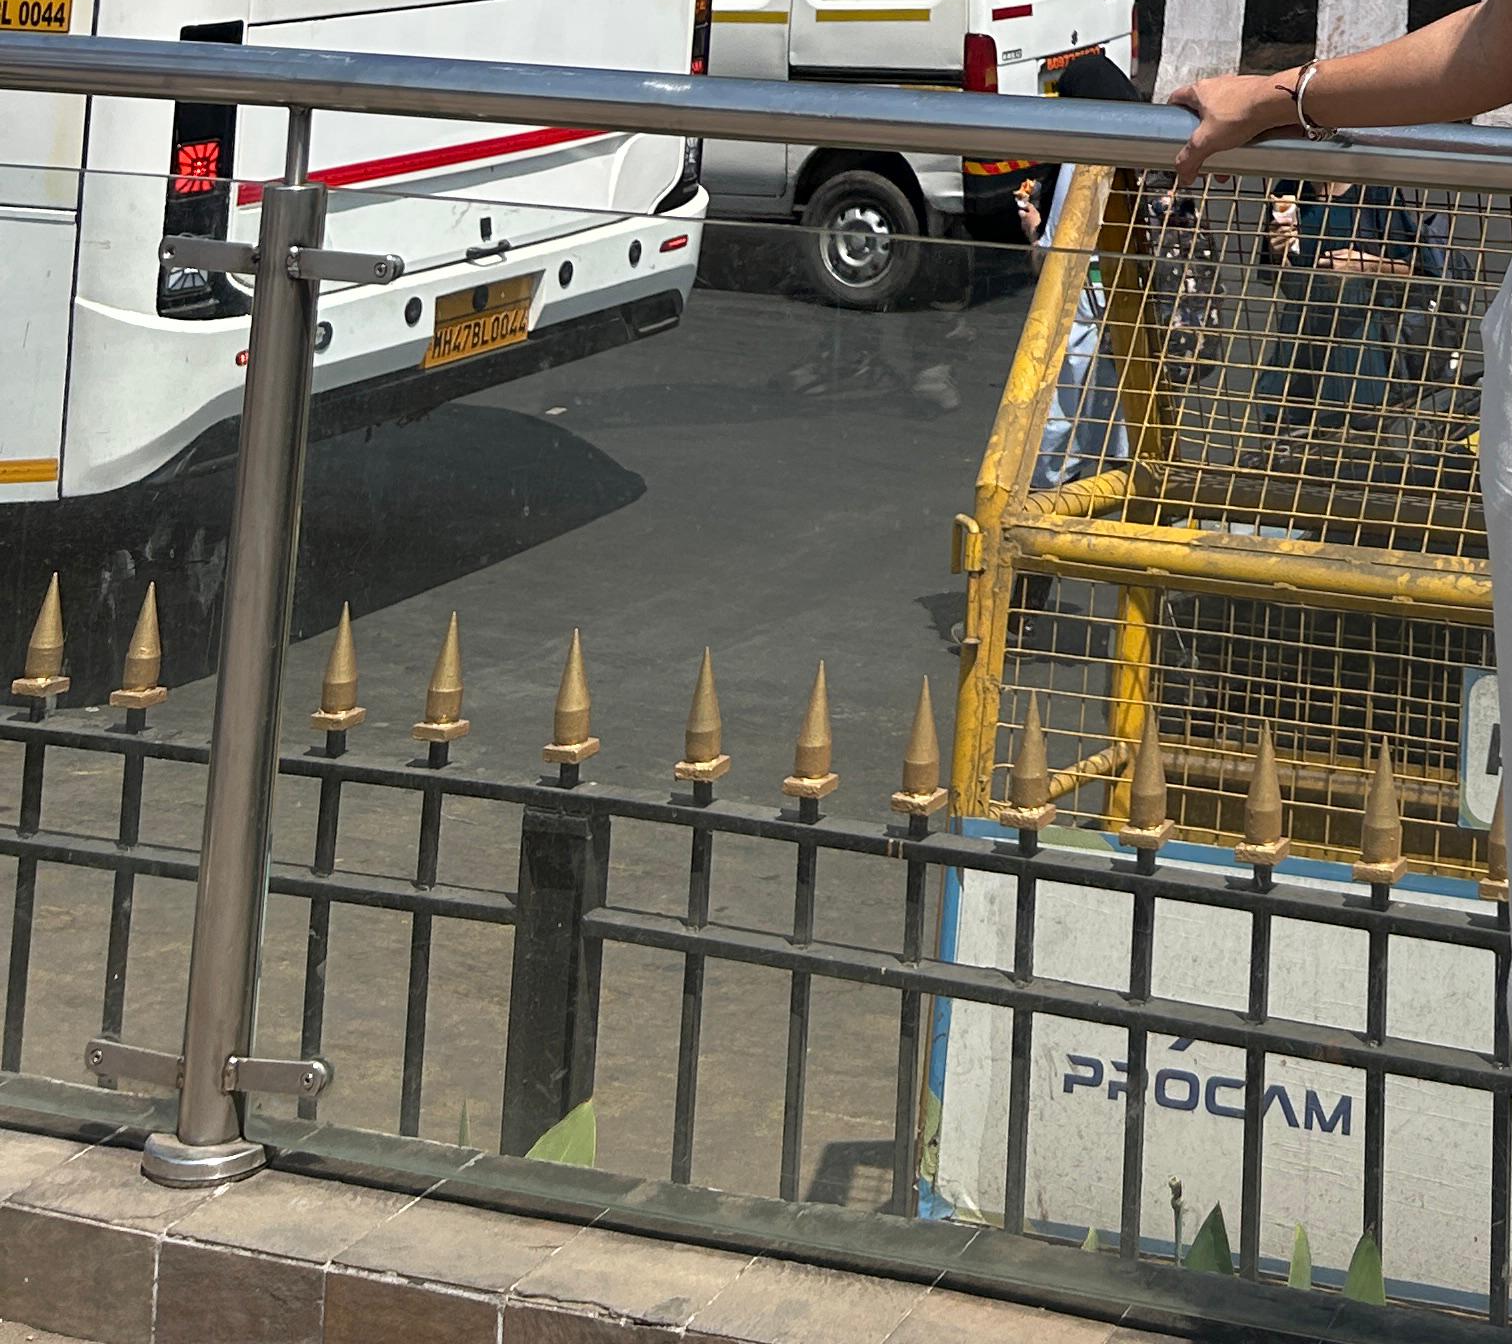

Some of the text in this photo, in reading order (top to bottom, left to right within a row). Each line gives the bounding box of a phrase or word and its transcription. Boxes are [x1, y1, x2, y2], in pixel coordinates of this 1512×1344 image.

[0, 0, 65, 27] L 0044
[432, 307, 527, 359] MH47BL0044
